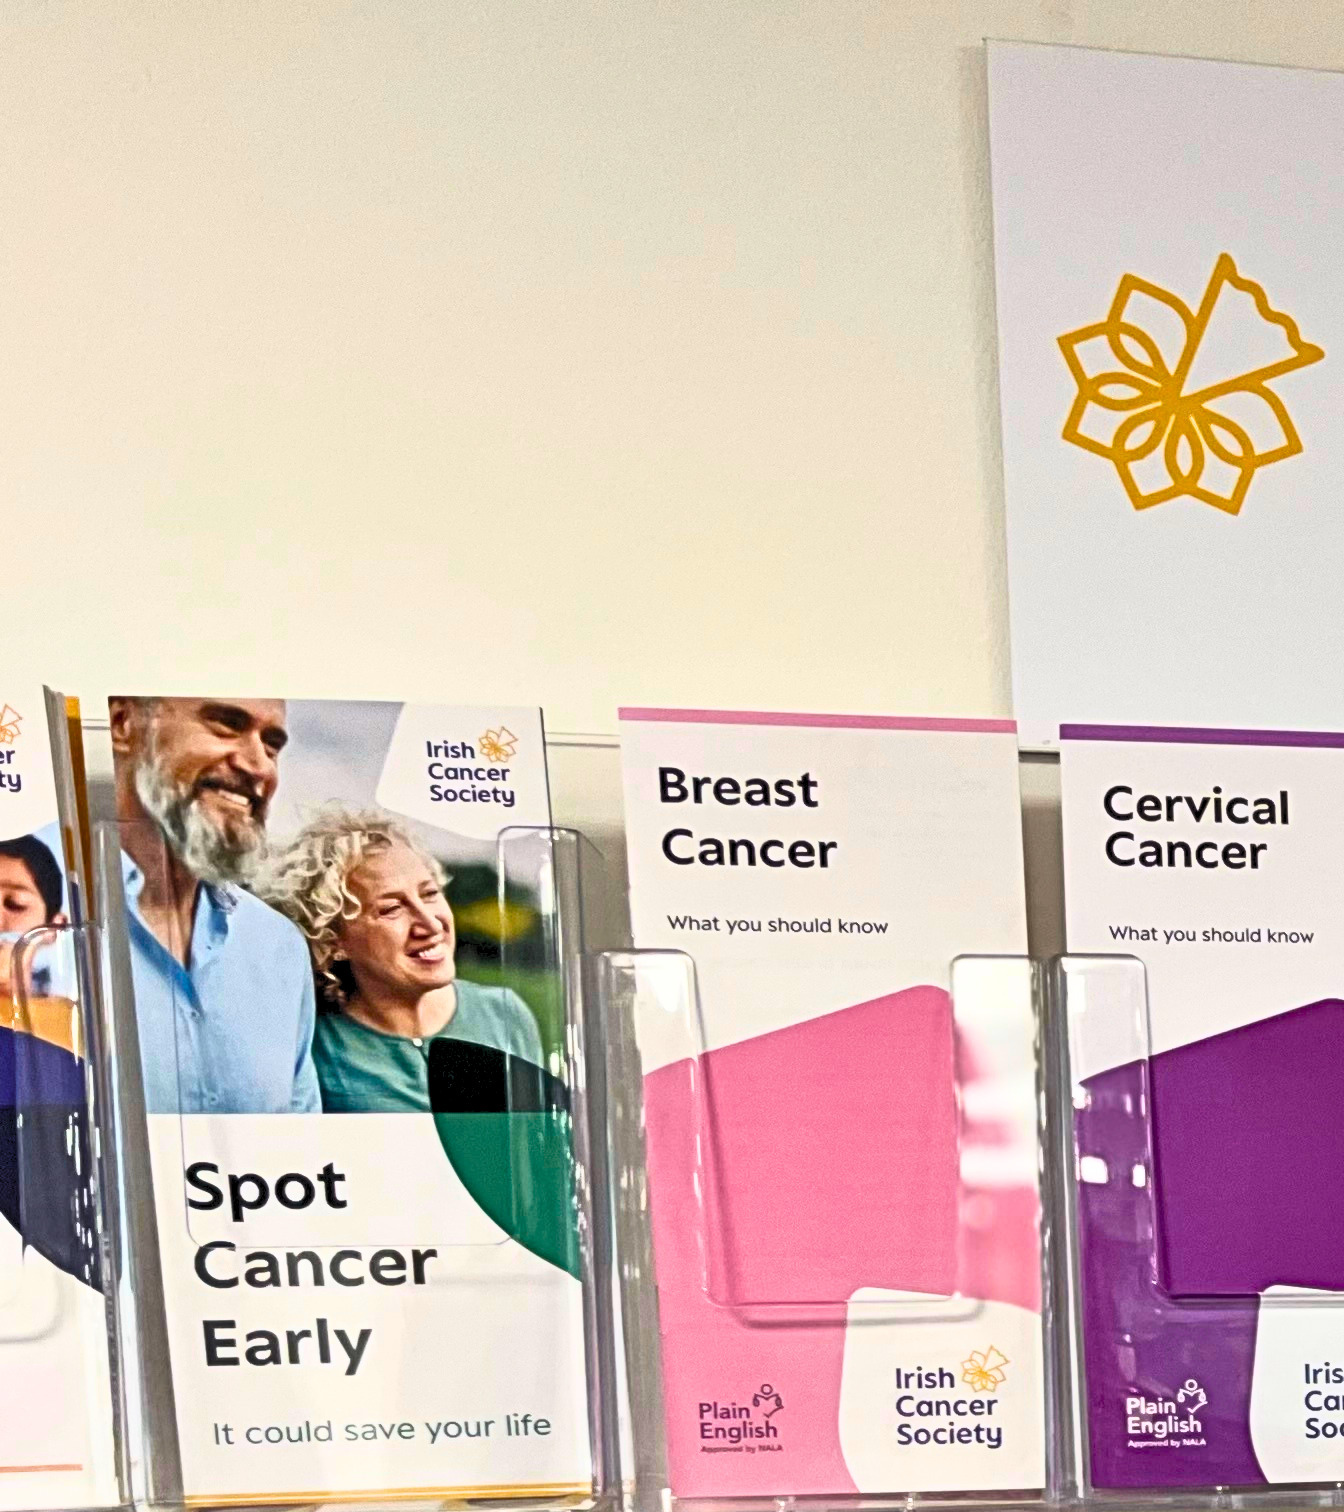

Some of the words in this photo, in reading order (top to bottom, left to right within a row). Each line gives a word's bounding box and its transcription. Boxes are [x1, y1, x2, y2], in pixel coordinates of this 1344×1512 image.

[426, 741, 476, 760] Irish
[428, 762, 511, 782] Cancer
[429, 783, 516, 807] Society
[658, 766, 819, 808] Breast
[1104, 785, 1290, 825] Cervical
[660, 828, 838, 870] Cancer
[1104, 832, 1267, 871] Cancer
[667, 914, 721, 934] What
[726, 918, 762, 938] you
[767, 915, 833, 935] should
[838, 917, 889, 935] know
[186, 1161, 347, 1222] Spot
[193, 1241, 437, 1290] Cancer
[201, 1317, 373, 1376] Early
[896, 1367, 955, 1390] Irish
[699, 1402, 751, 1420] Plain
[896, 1395, 999, 1418] Cancer
[1126, 1397, 1177, 1416] Plain
[212, 1424, 238, 1446] It
[245, 1419, 333, 1446] could
[345, 1422, 415, 1443] save
[426, 1417, 496, 1443] your
[506, 1413, 552, 1438] life
[699, 1420, 779, 1443] English
[896, 1422, 1003, 1449] Society
[1127, 1416, 1202, 1438] English
